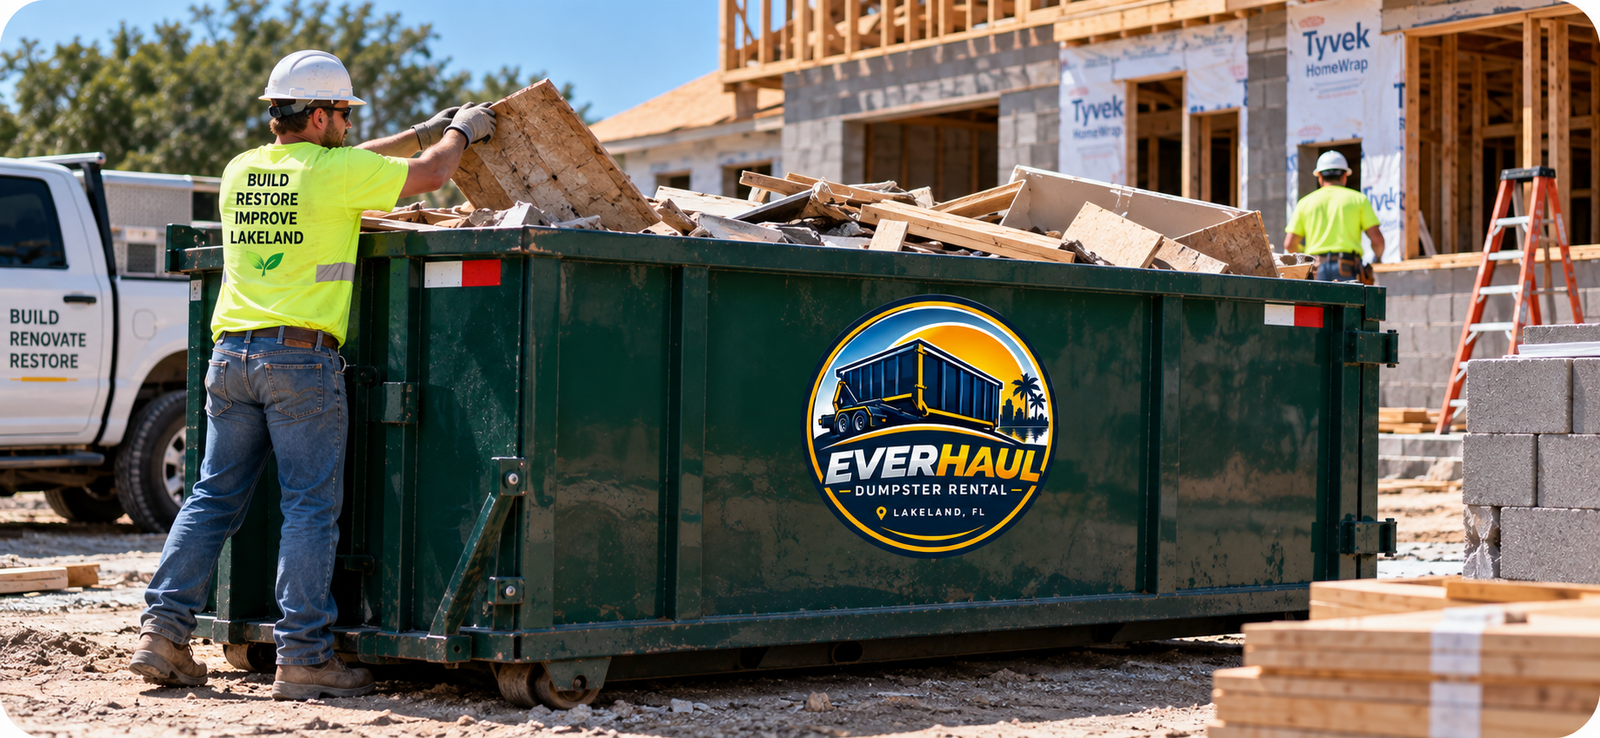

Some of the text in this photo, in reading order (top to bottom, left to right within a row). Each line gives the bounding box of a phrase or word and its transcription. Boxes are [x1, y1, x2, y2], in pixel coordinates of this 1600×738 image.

[1302, 22, 1370, 61] Tyvek
[1306, 58, 1368, 77] HomeWrap
[1072, 95, 1124, 126] Tyvek
[247, 173, 289, 187] BUILD
[235, 192, 298, 206] RESTORE
[234, 211, 297, 225] IMPROVE
[230, 230, 304, 245] LAKELAND
[10, 309, 59, 325] BUILD
[10, 331, 87, 348] RENOVATE
[10, 353, 78, 369] RESTORE
[825, 444, 1043, 485] EVERHAUL
[855, 484, 1007, 497] DUMPSTER RENTAL
[893, 507, 985, 518] LAKELAND, FL
